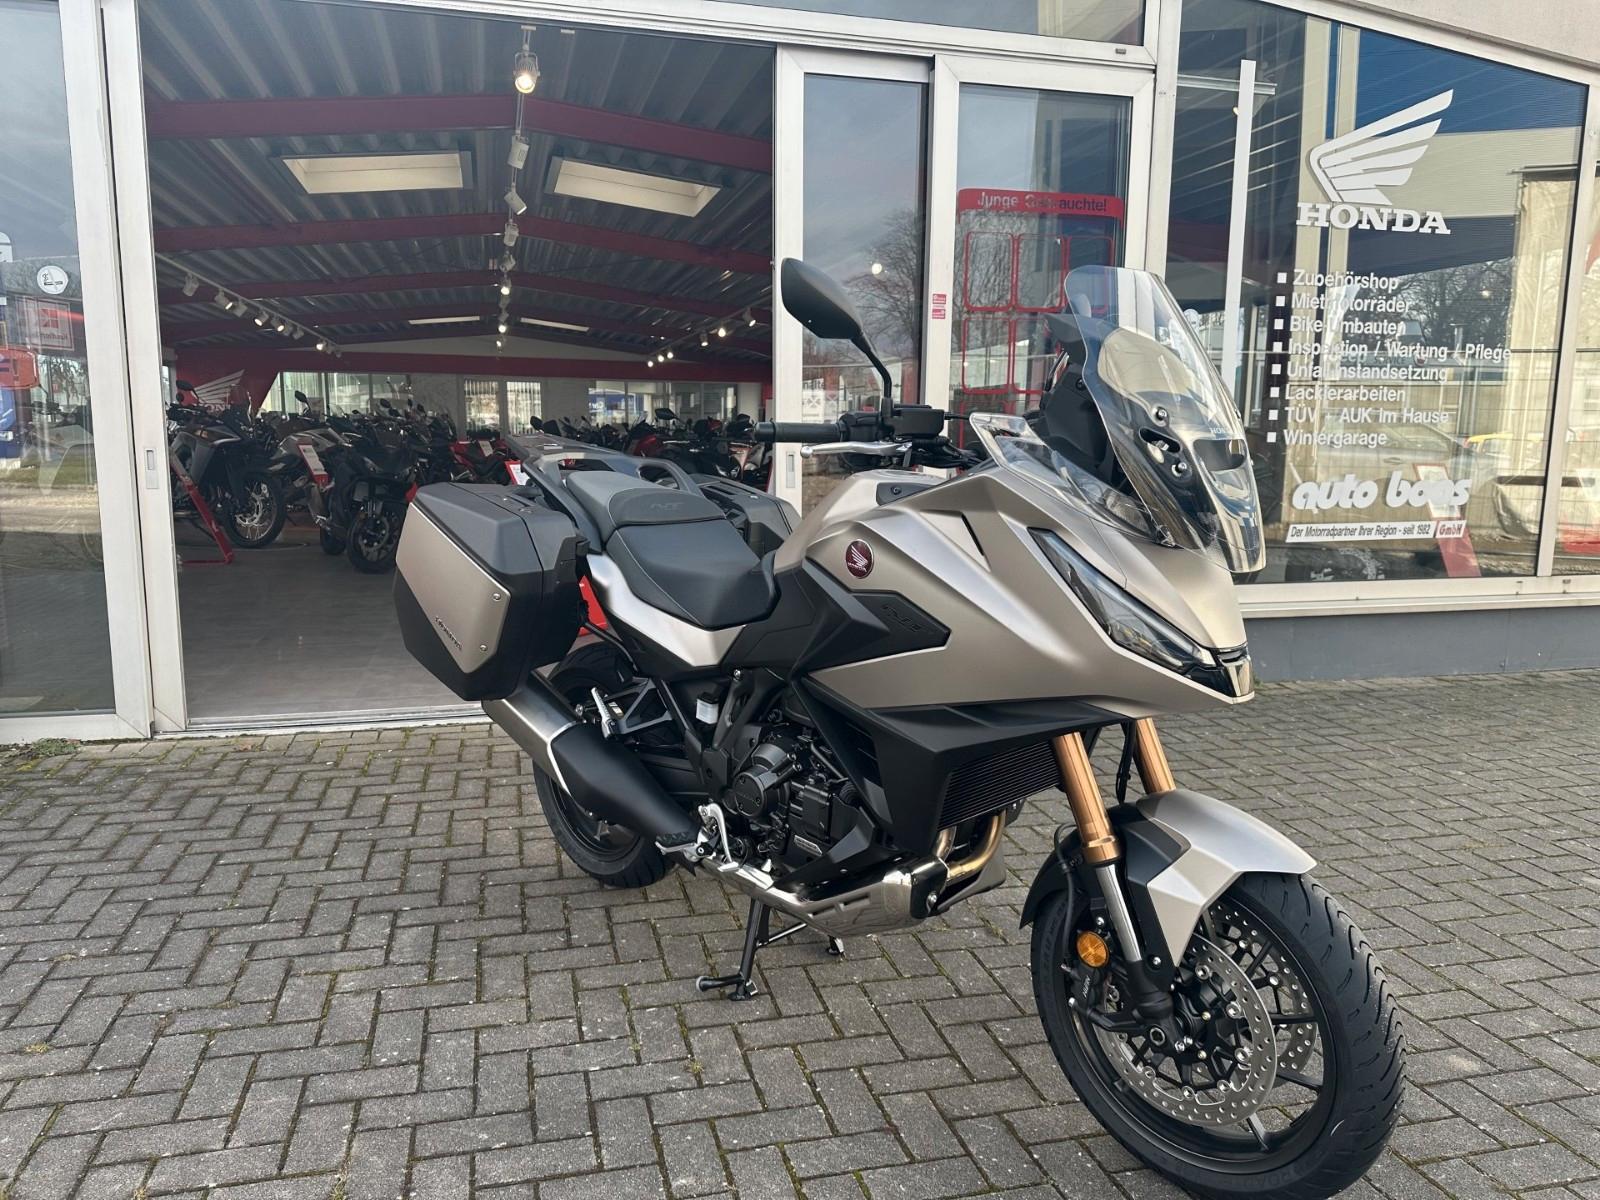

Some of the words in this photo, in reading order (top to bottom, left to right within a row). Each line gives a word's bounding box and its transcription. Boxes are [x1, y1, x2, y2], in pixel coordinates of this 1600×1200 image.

[977, 191, 1019, 209] Junge
[1296, 201, 1451, 235] HONDA
[1292, 269, 1399, 293] Zubehörshop
[1386, 341, 1448, 362] Wartung
[1465, 343, 1512, 363] Pflege
[1284, 383, 1406, 402] Lackierarbeiten
[1284, 404, 1317, 423] TÜV
[1339, 407, 1373, 424] AUK
[1402, 407, 1449, 424] Hause
[1283, 429, 1388, 449] Wintergarage
[1292, 473, 1379, 510] auto
[1290, 526, 1304, 537] Der
[1304, 525, 1358, 539] Motorradpartner
[1374, 524, 1398, 538] Region
[1402, 524, 1416, 535] seit
[1439, 523, 1464, 536] GmbH
